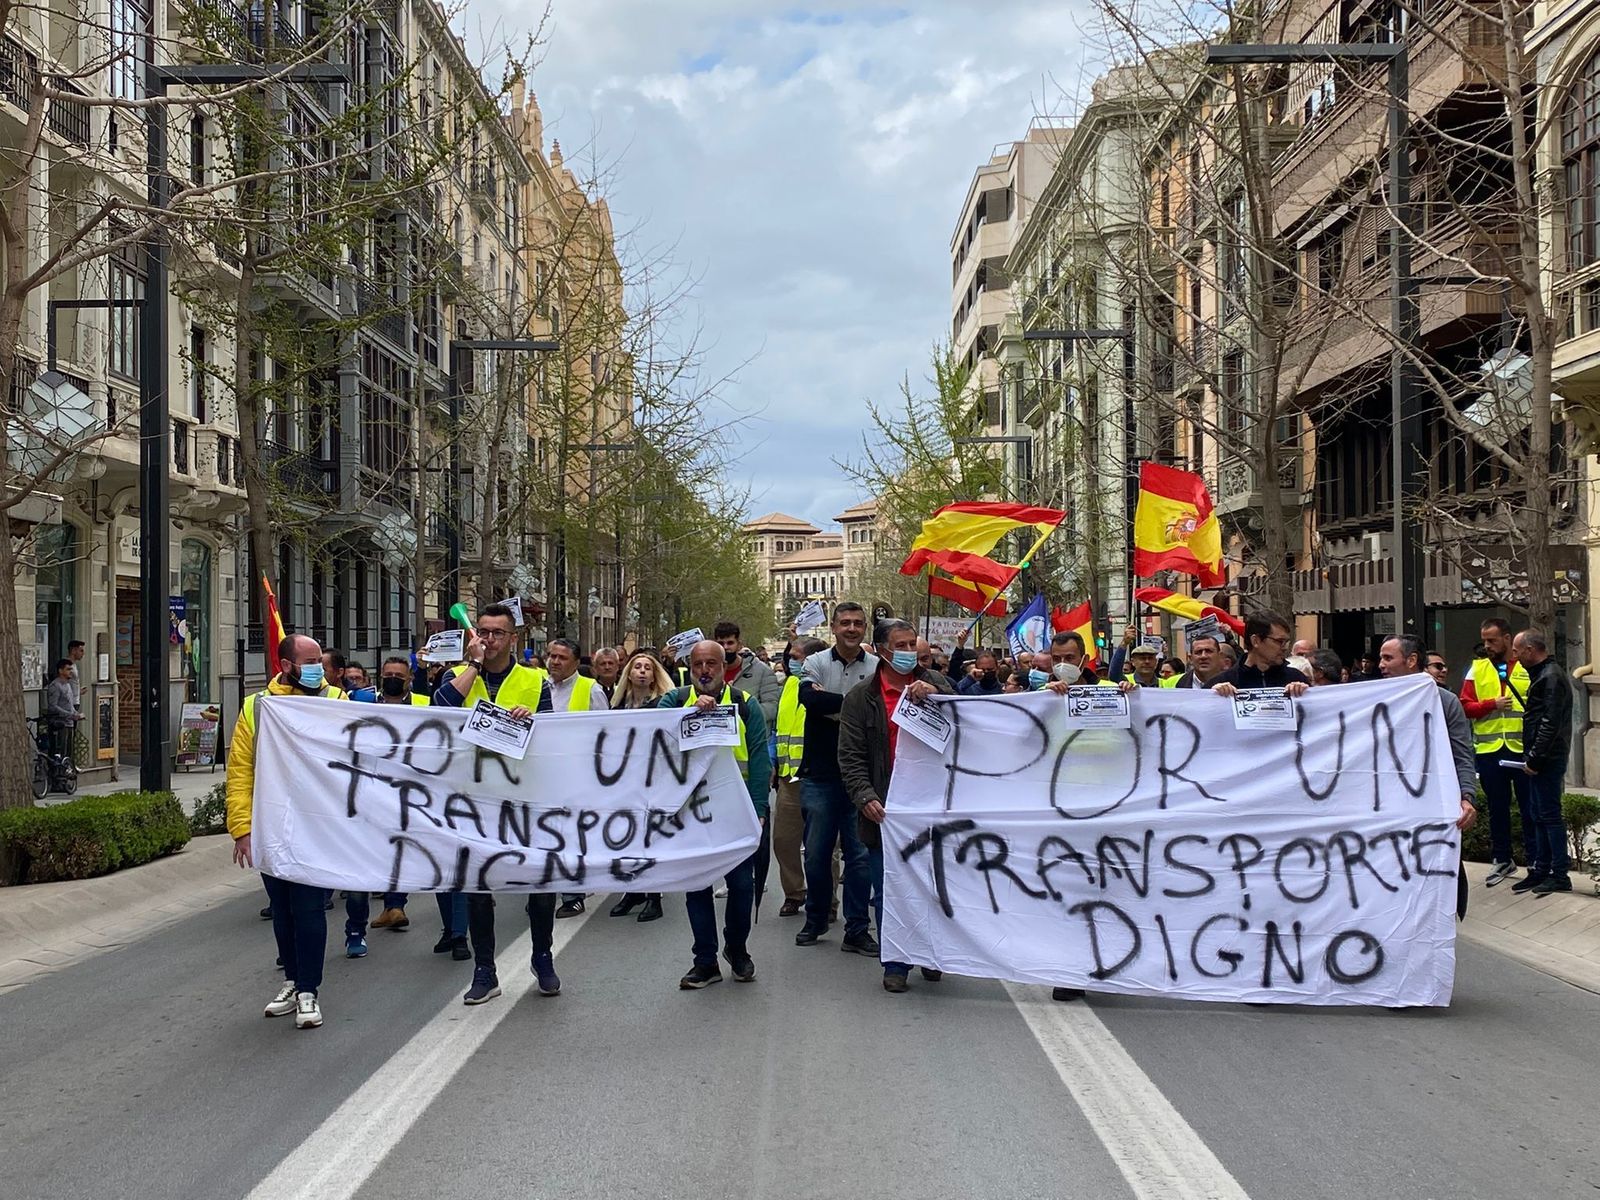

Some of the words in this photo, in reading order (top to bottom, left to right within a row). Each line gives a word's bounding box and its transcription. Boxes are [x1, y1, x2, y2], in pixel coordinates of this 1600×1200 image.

[342, 715, 520, 785] POR
[594, 726, 690, 788] UN
[944, 699, 1228, 820] POR
[1295, 701, 1432, 811] UN
[901, 819, 1456, 918] TRANSPORTE
[1068, 901, 1385, 988] DIGNO
